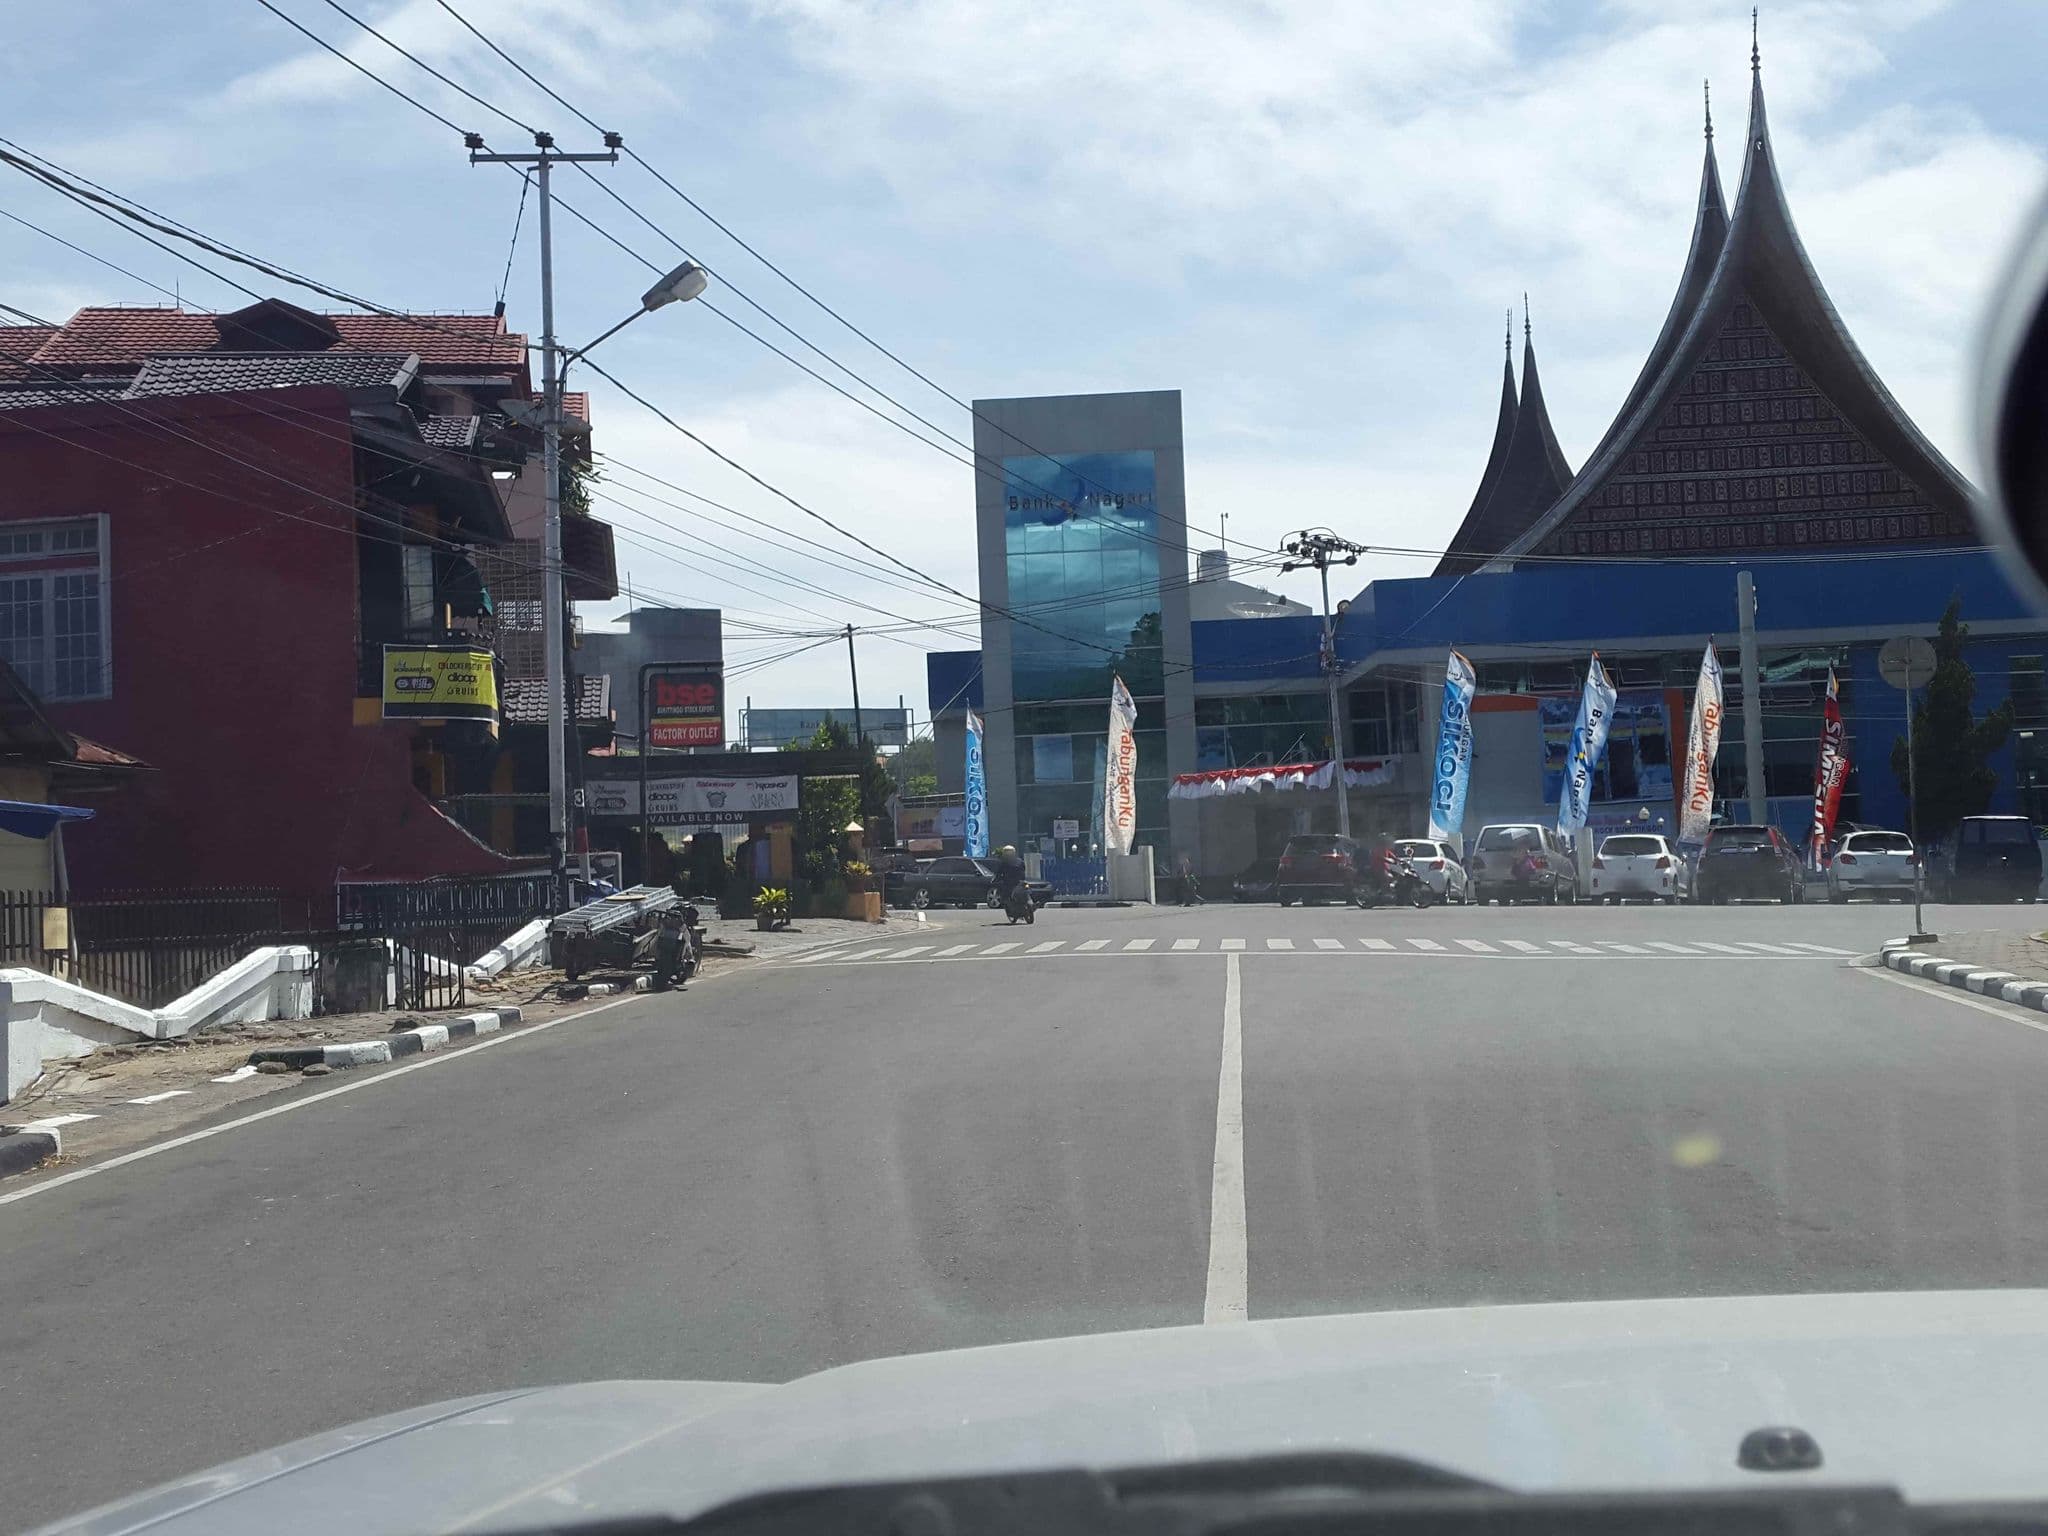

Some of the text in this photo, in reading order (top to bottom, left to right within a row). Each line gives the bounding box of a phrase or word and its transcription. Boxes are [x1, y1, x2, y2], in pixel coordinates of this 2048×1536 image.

[1009, 491, 1152, 511] Bank Nagari
[656, 678, 716, 705] bse
[653, 726, 719, 740] FACTORY OUTLET
[1436, 700, 1464, 812] SIKOCI
[649, 812, 744, 824] VAILABLE NOW
